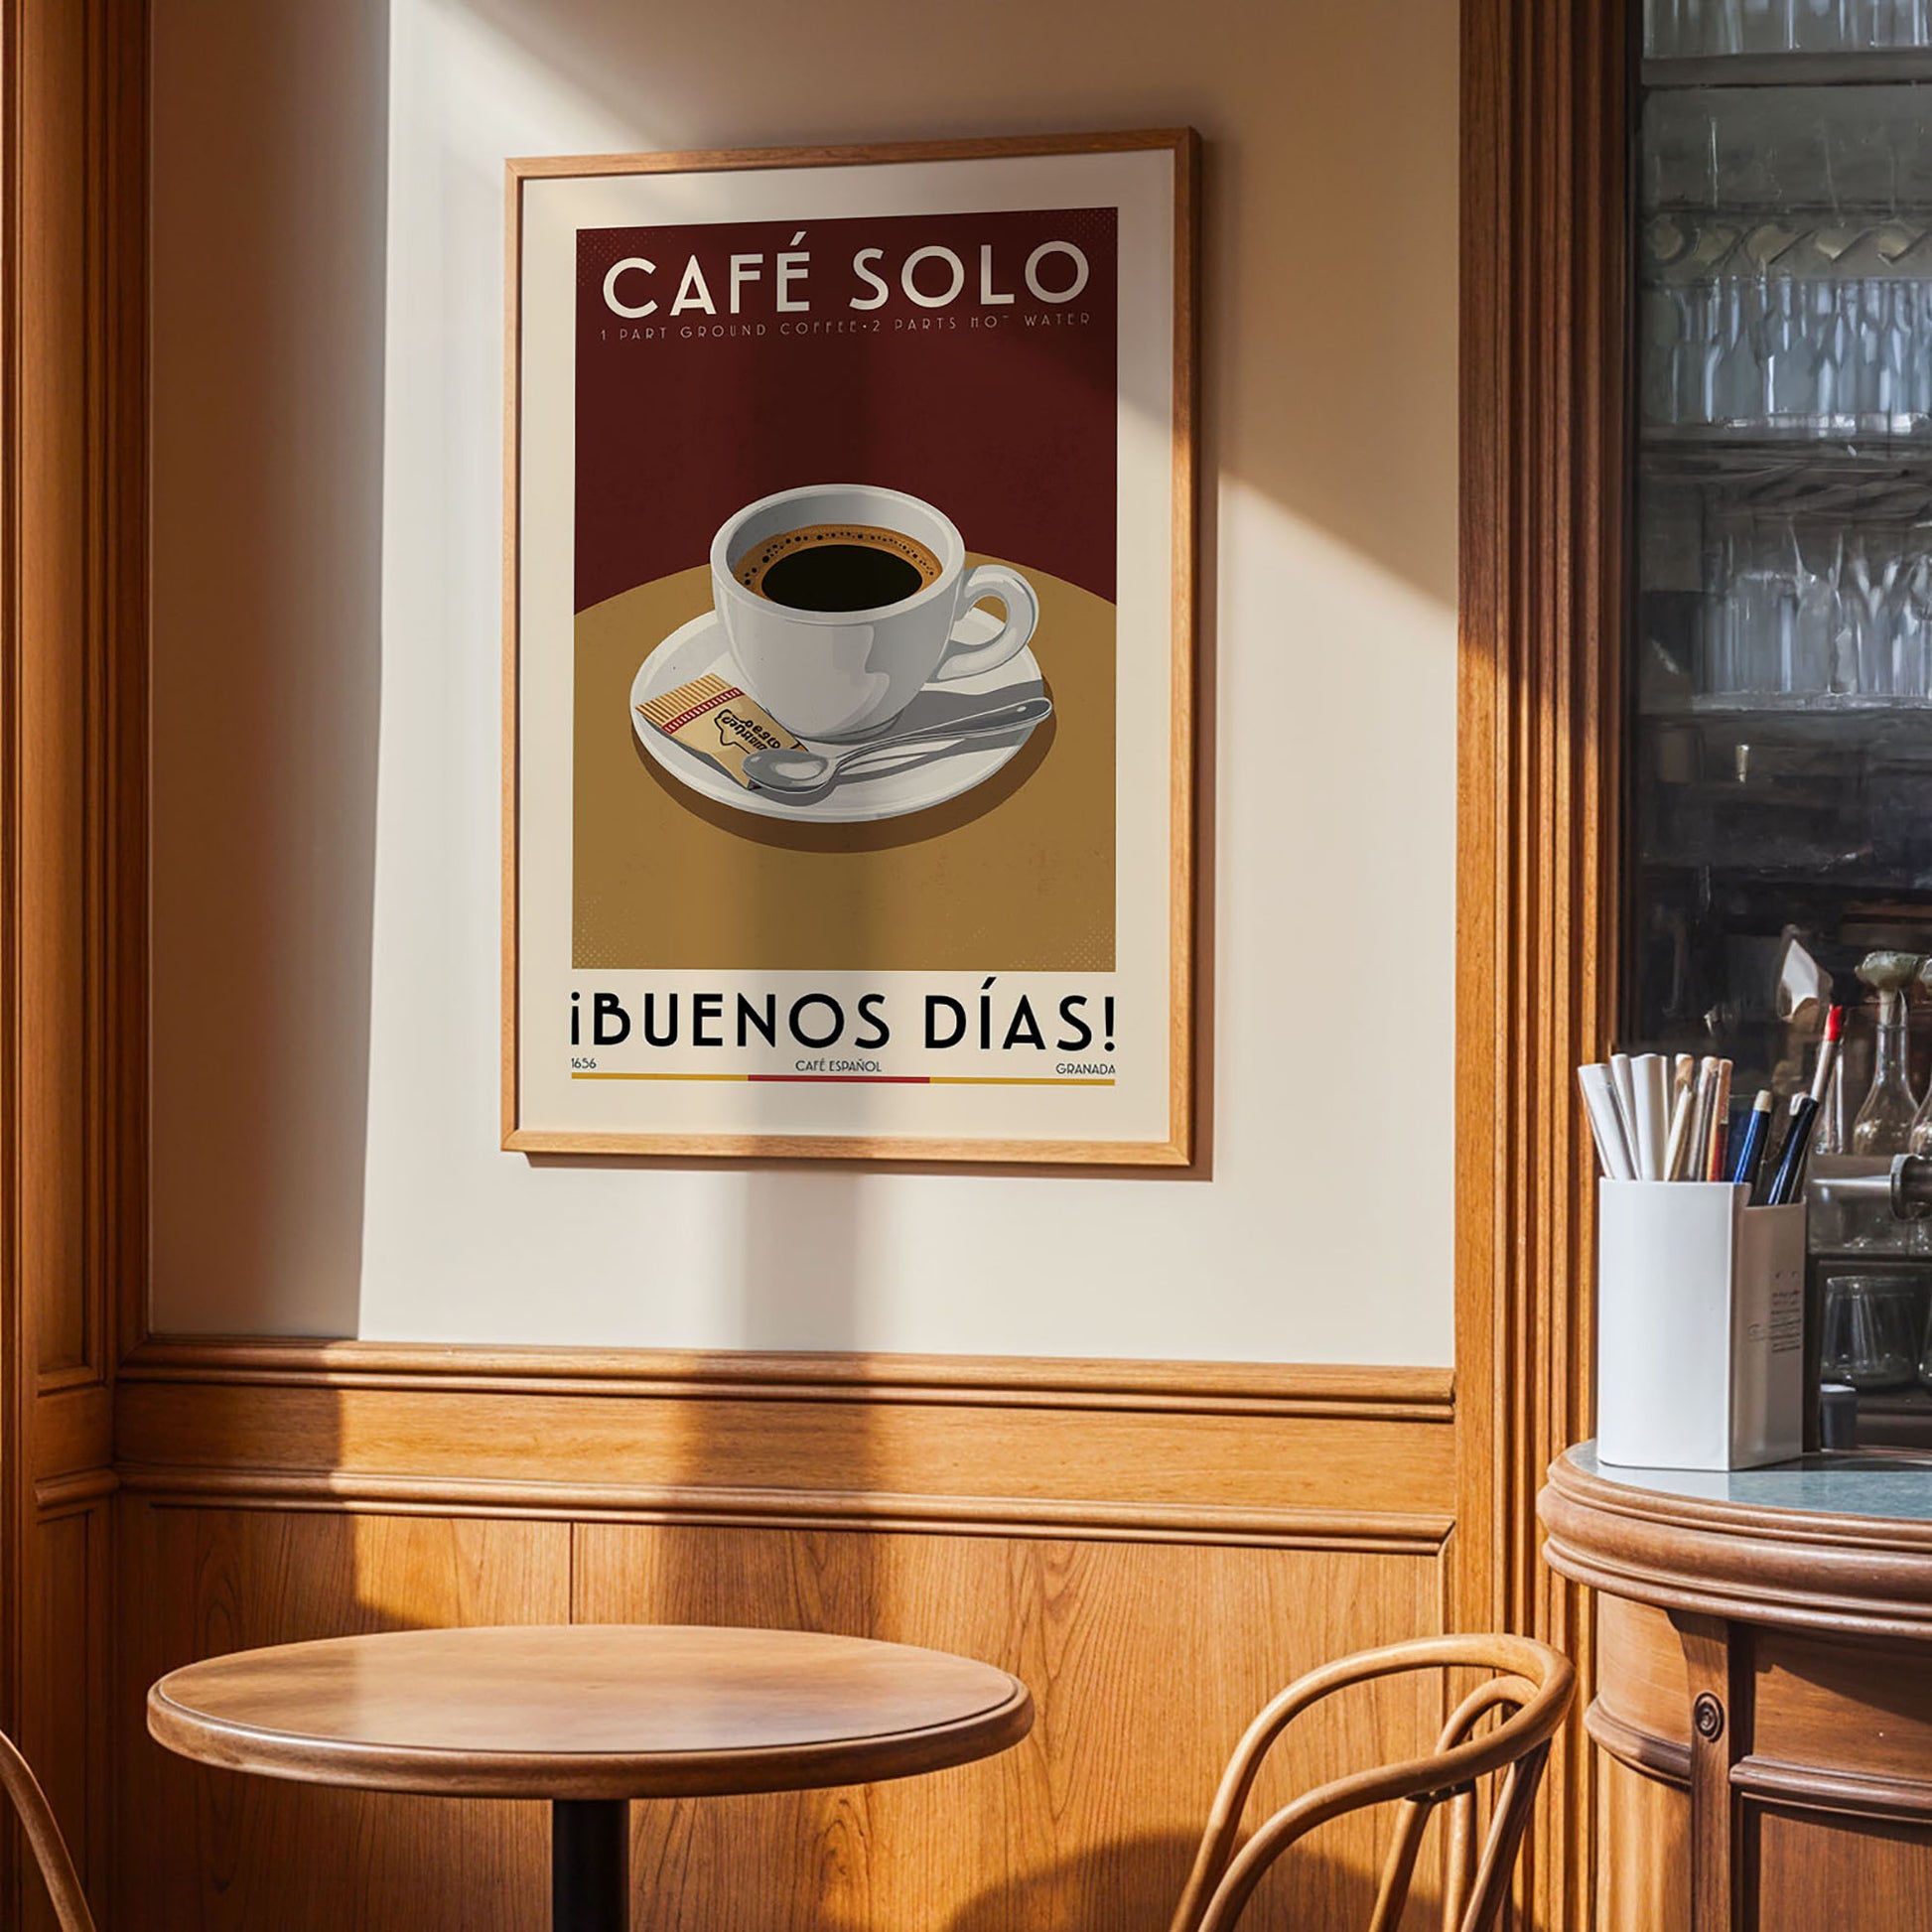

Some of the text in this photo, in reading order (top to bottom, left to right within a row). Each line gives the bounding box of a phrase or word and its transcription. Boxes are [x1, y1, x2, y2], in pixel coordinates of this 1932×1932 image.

[602, 230, 1090, 319] CAFÉ SOLO
[600, 329, 607, 341] 1
[620, 327, 667, 341] PART
[679, 324, 766, 339] GROUND
[894, 316, 957, 331] PARTS
[1024, 312, 1091, 327] WATER
[571, 976, 1117, 1052] ¡BUENOS DÍAS!
[571, 1057, 597, 1069] 1656
[794, 1057, 883, 1073] CAFÉ ESPAÑOL
[1055, 1062, 1116, 1075] GRANADA
